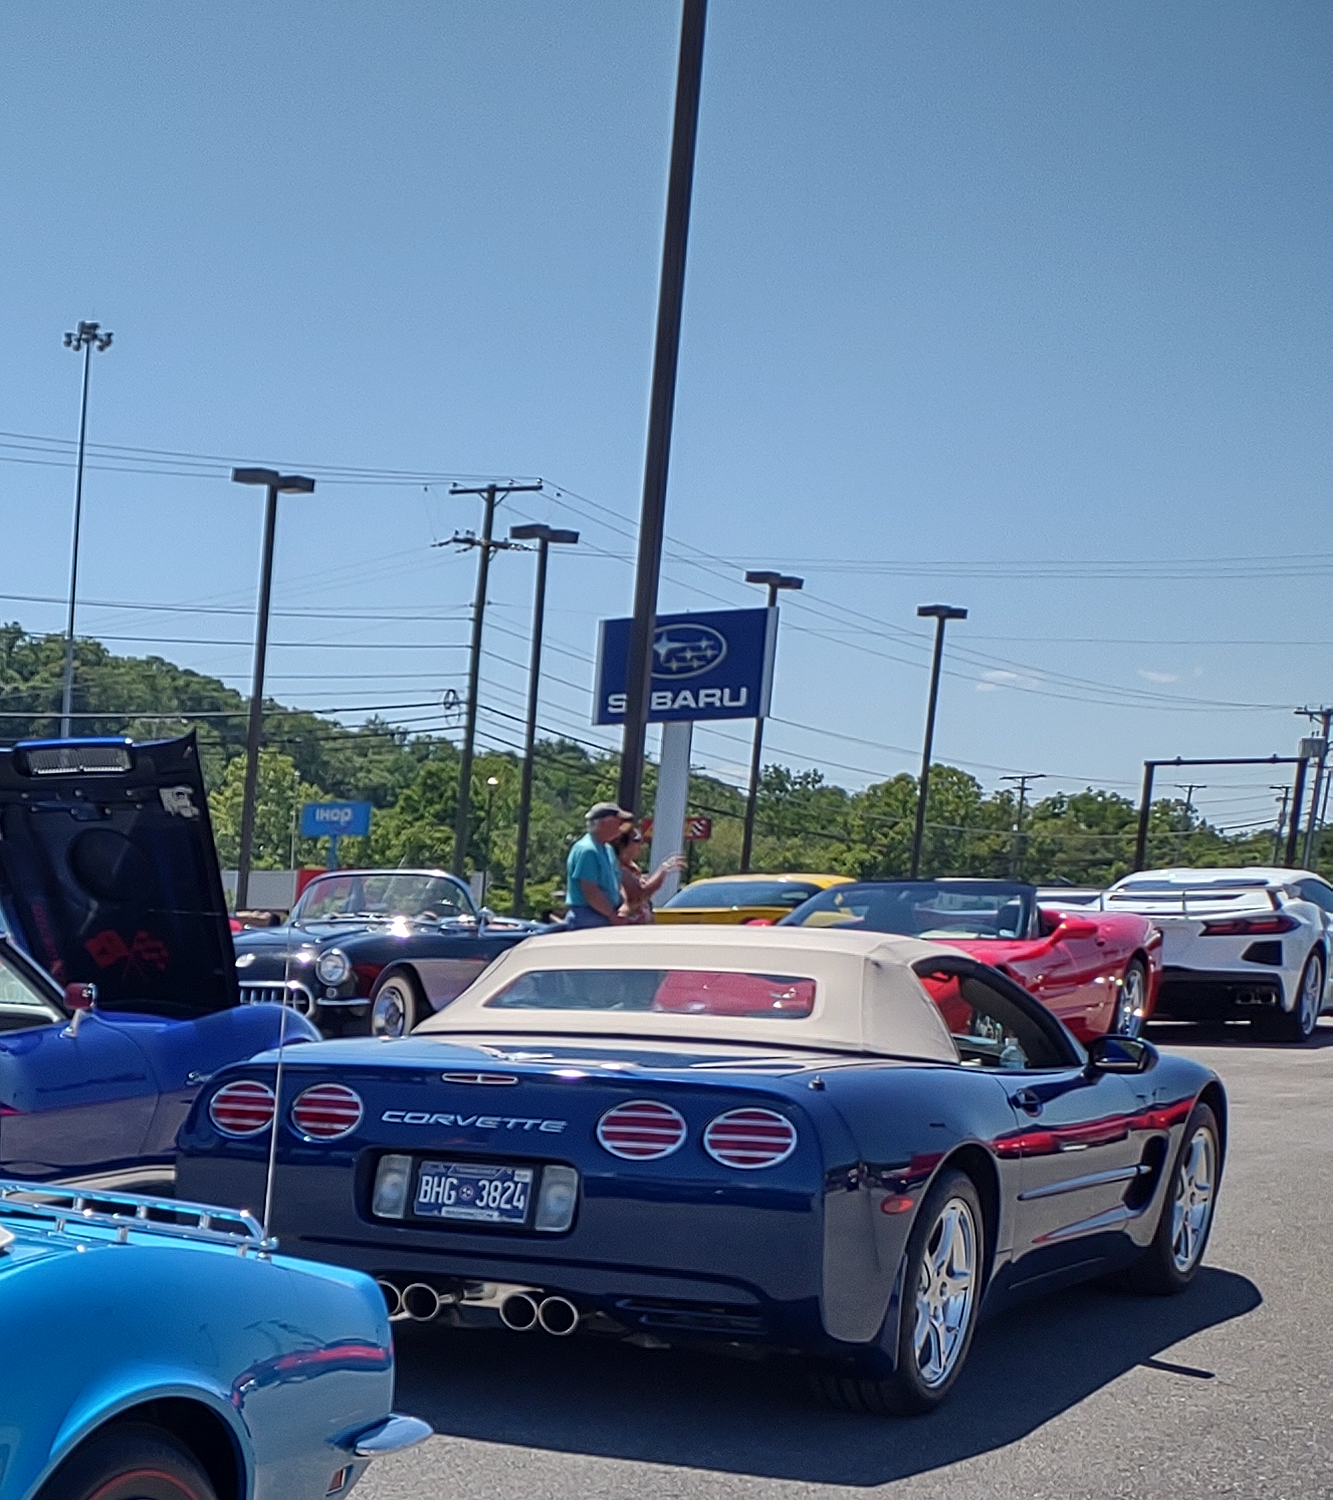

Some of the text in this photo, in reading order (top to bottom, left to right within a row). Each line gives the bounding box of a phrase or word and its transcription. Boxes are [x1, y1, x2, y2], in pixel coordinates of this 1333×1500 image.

[608, 687, 748, 713] SBARU
[381, 1110, 568, 1133] CORVETTE
[418, 1175, 526, 1210] BHG 3824
